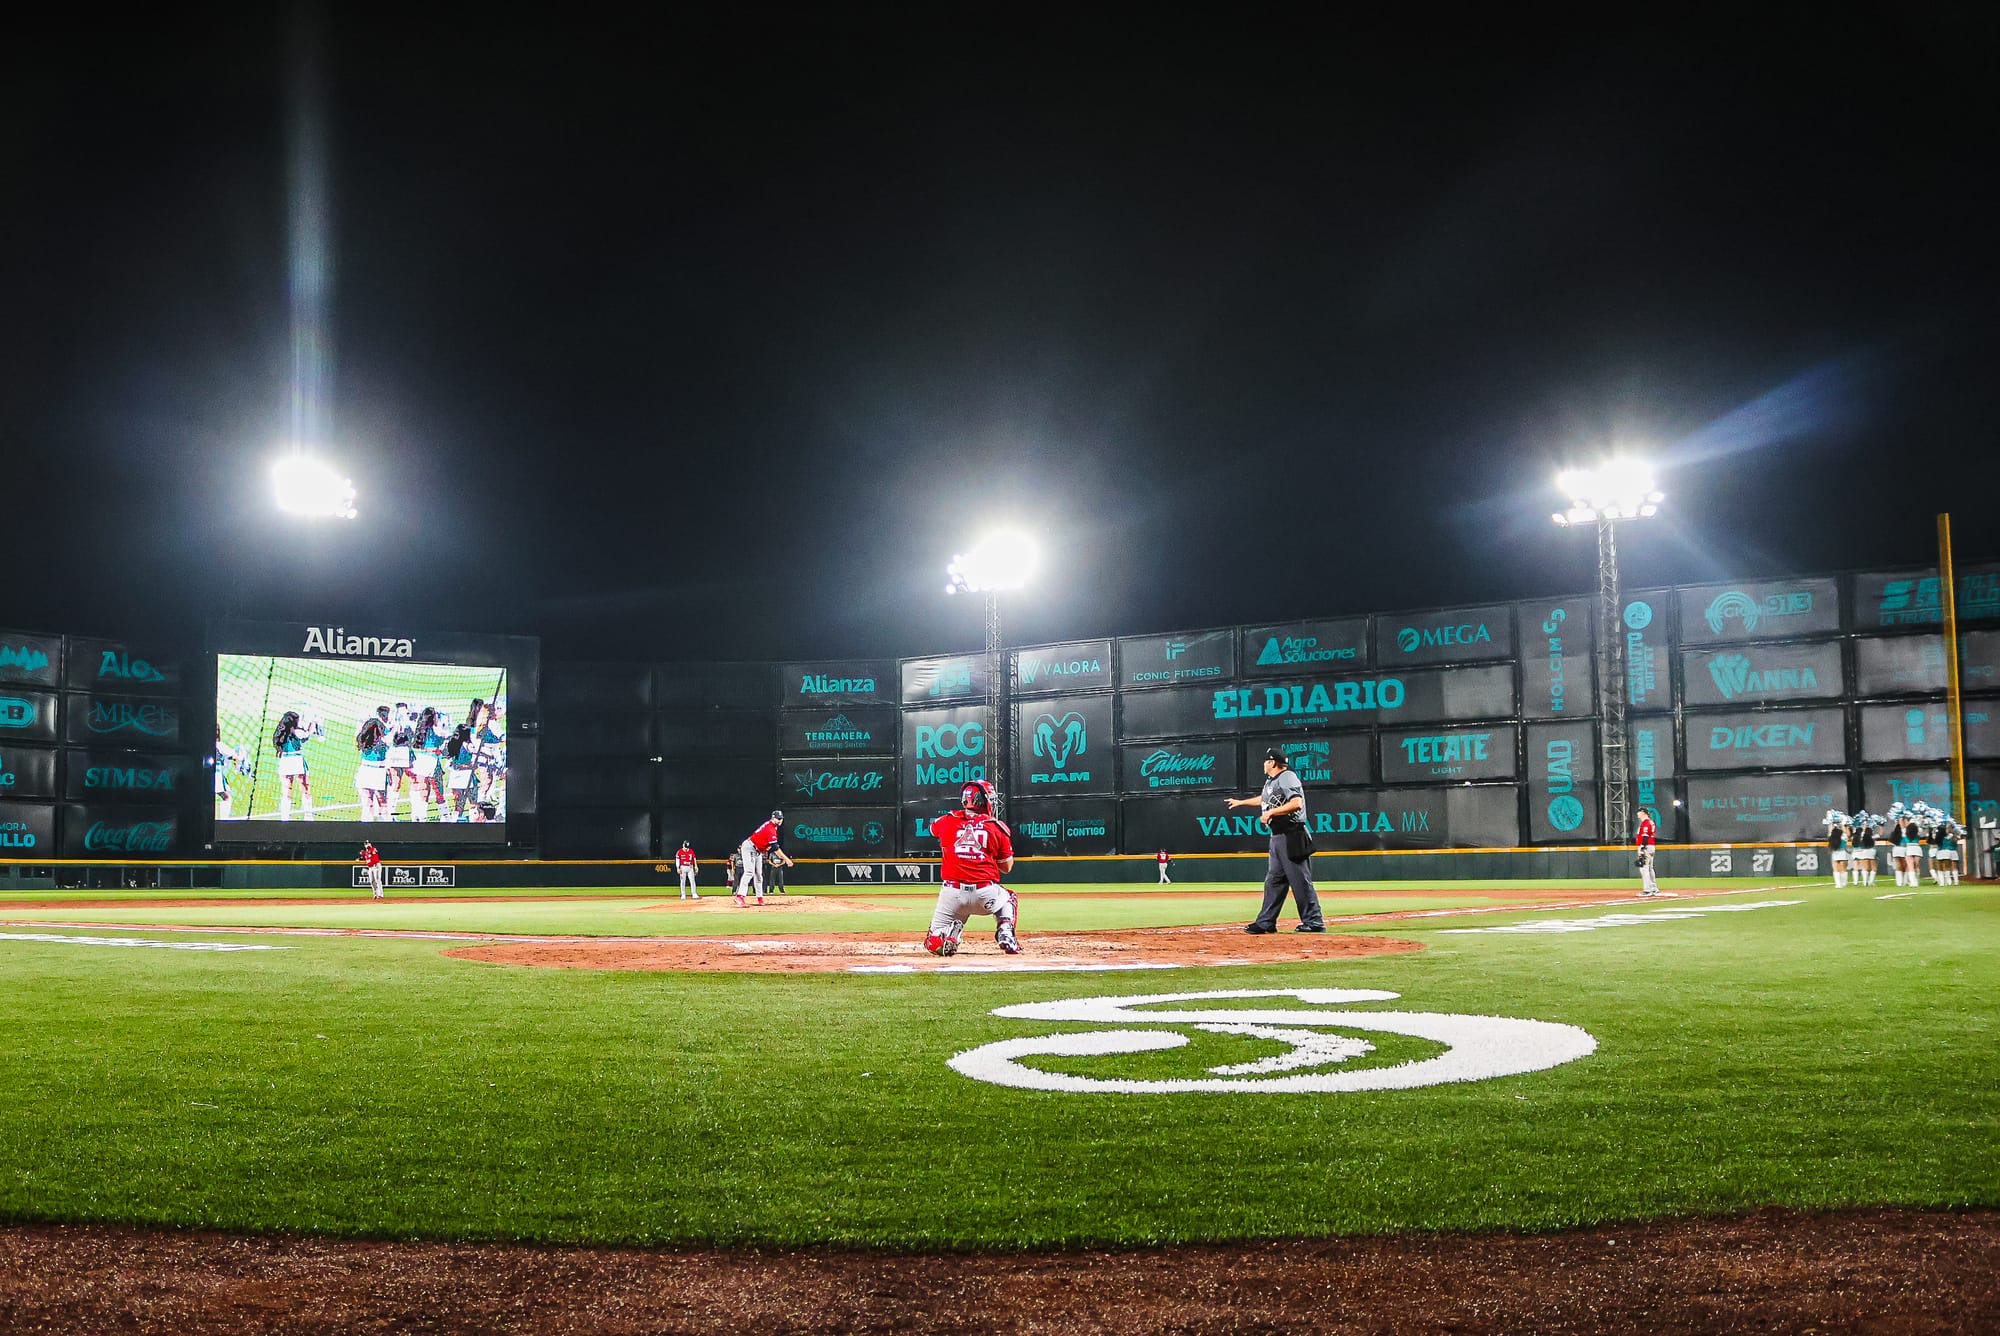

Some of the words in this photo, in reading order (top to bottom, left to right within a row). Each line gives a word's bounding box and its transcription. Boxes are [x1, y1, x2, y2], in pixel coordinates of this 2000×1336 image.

[303, 627, 412, 658] Alianza
[1281, 636, 1317, 650] Agro
[1422, 623, 1491, 647] MEGA
[1282, 648, 1356, 665] Soluciones
[1043, 659, 1101, 676] VALORA
[1174, 666, 1221, 680] FITNESS
[1549, 637, 1565, 711] HOLCIM
[800, 674, 876, 694] Alianza
[804, 732, 871, 741] TERRANERA
[916, 722, 984, 760] RCG
[1710, 722, 1815, 749] DIKEN
[1401, 734, 1492, 764] TECATE
[1141, 749, 1216, 777] Caliente
[1431, 767, 1463, 775] LIGHT
[1547, 740, 1573, 793] UAD
[84, 768, 173, 790] SIMSA
[816, 772, 860, 791] Carl's
[916, 761, 985, 786] Media
[1031, 771, 1090, 784] RAM
[1160, 776, 1213, 786] caliente.mx
[1303, 769, 1331, 781] JUAN
[1702, 793, 1834, 811] MULTIMEDIOS
[793, 823, 855, 839] COAHUILA
[1067, 827, 1105, 837] CONTIGO
[1197, 811, 1395, 837] VANGRDIA
[1402, 811, 1430, 832] MX
[1710, 855, 1733, 873] 23
[1752, 854, 1775, 872] 27
[1796, 853, 1819, 871] 28
